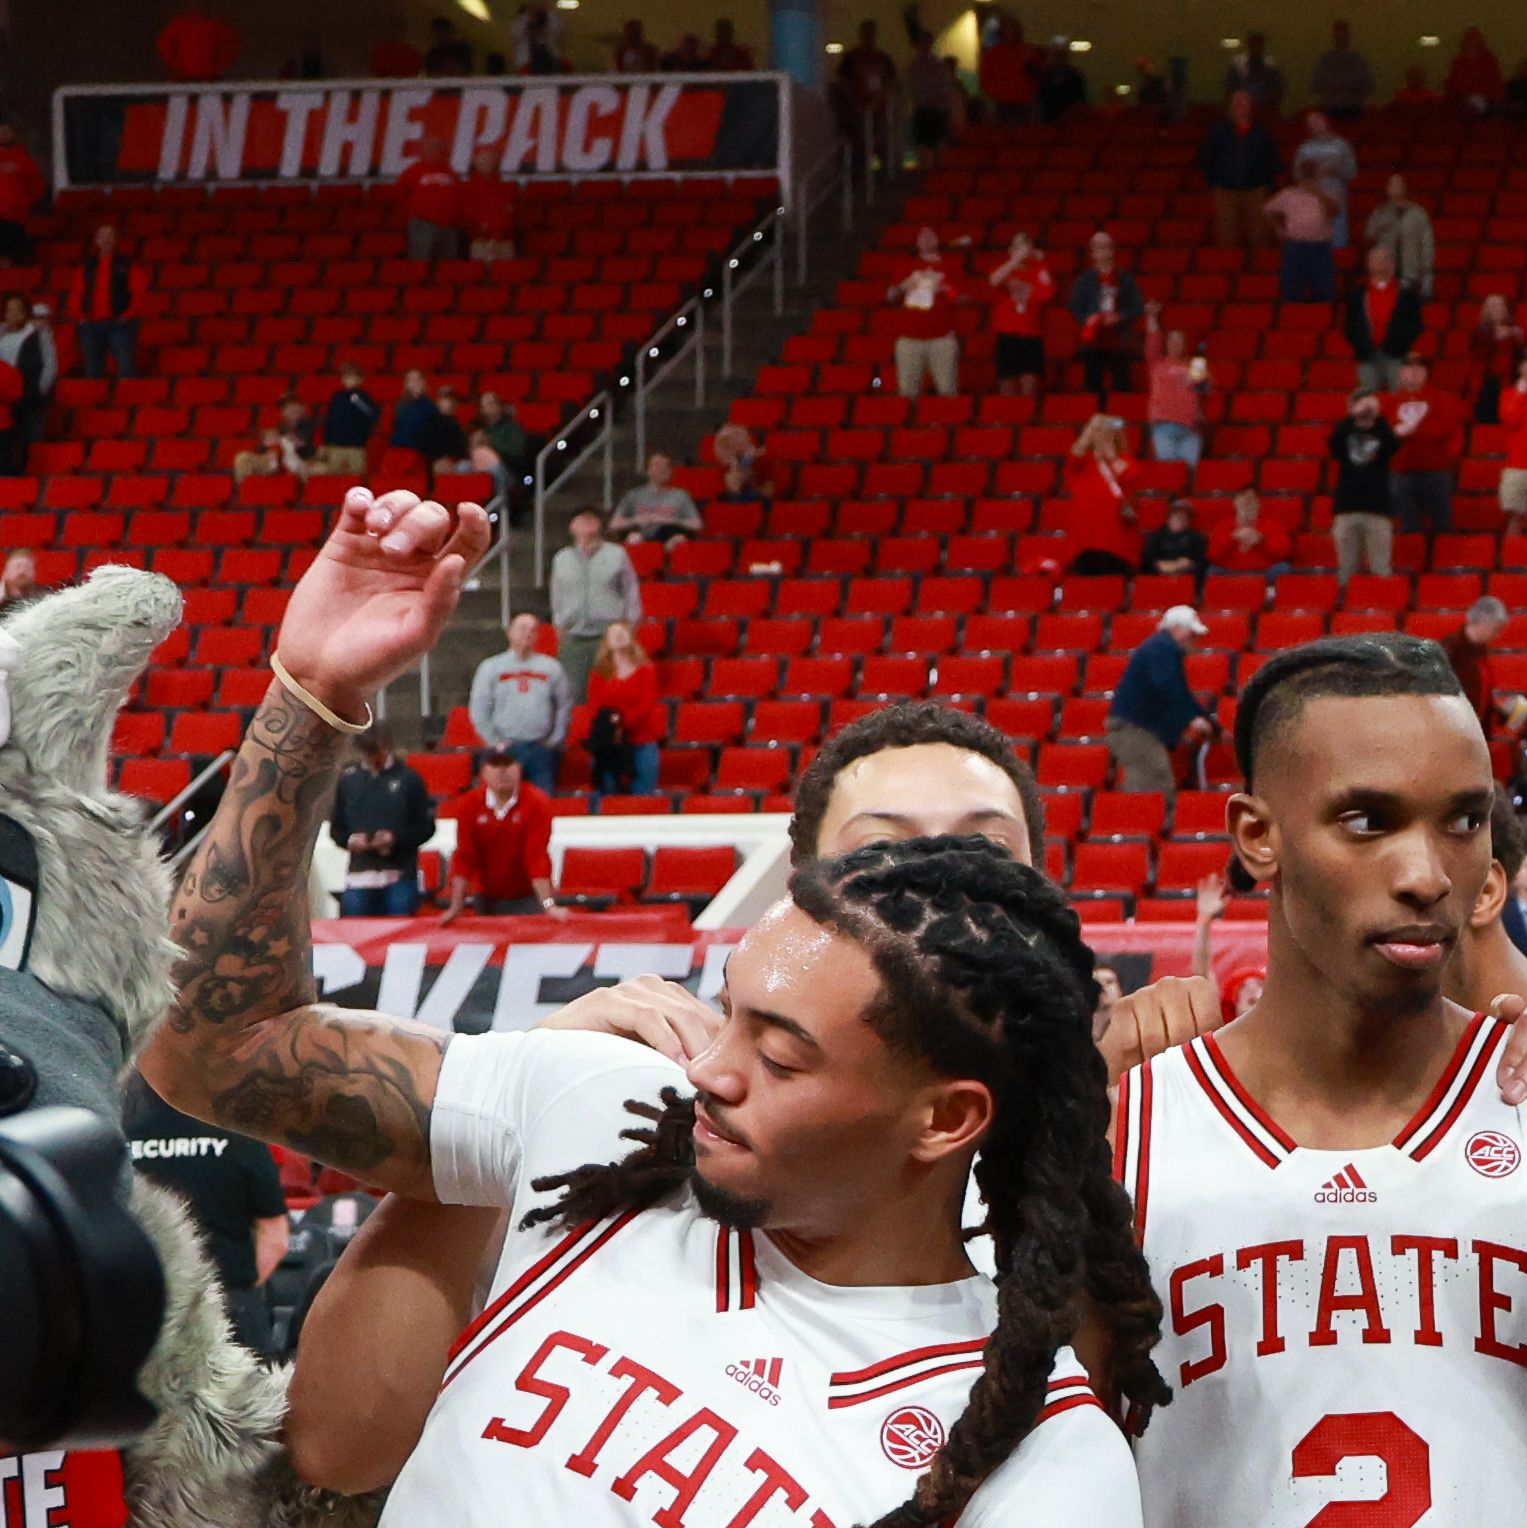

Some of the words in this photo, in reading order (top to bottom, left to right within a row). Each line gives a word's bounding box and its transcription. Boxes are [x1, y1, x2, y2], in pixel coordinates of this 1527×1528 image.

[158, 94, 250, 180] IN
[277, 87, 433, 179] THE
[452, 84, 682, 173] PACK
[126, 1136, 229, 1160] ECURITY
[1313, 1186, 1378, 1204] adidas
[724, 1361, 782, 1407] adidas
